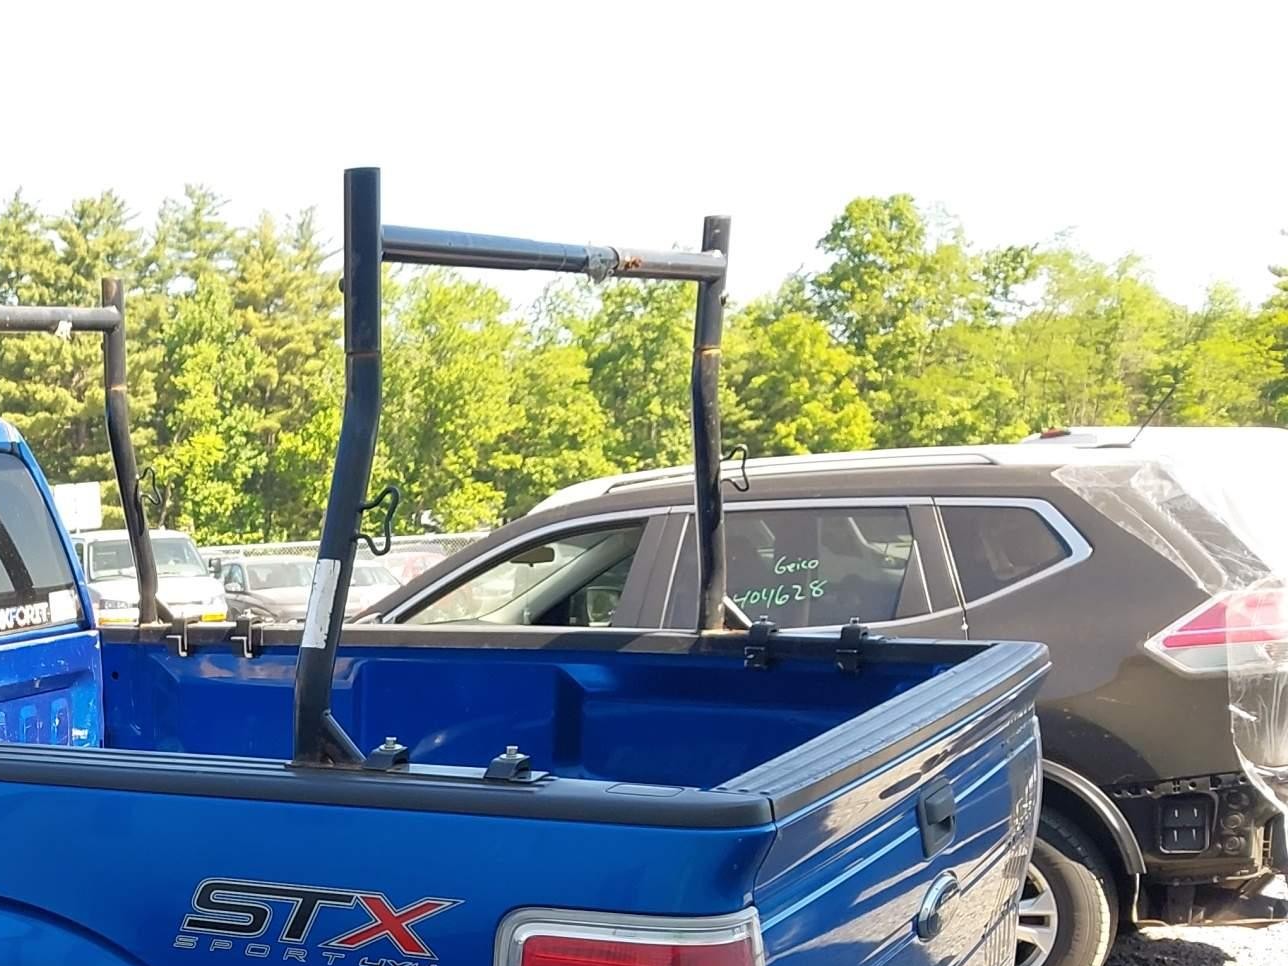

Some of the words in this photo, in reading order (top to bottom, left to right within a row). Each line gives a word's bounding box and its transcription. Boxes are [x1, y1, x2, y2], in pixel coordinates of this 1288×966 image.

[774, 556, 819, 574] Geico
[180, 878, 465, 960] STX
[173, 935, 345, 965] SPORT
